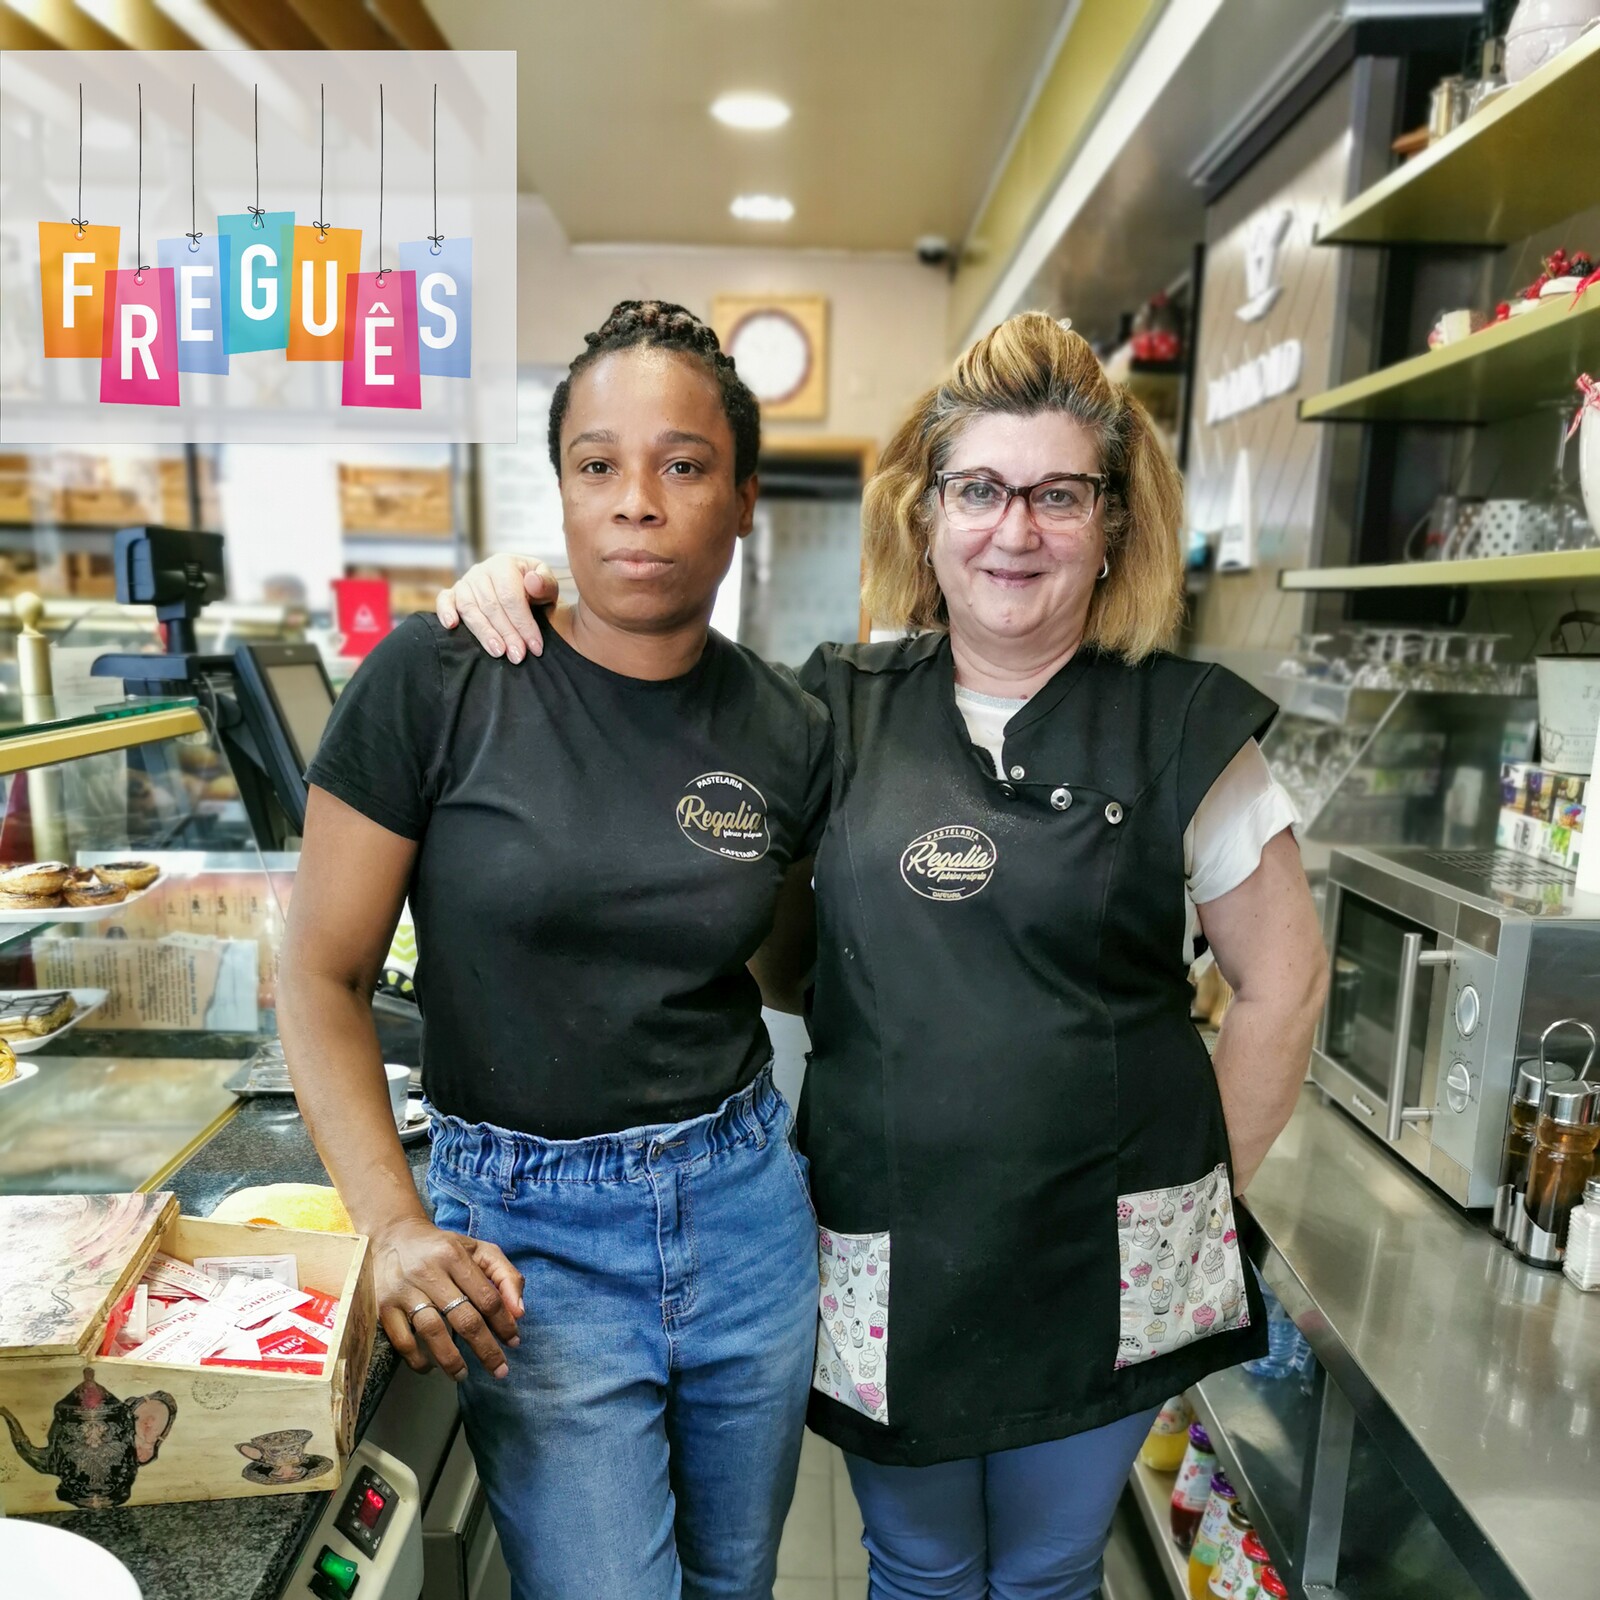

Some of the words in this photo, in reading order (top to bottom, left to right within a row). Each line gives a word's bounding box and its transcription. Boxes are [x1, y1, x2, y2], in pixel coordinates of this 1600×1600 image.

[696, 776, 743, 791] PASTELARIA
[680, 795, 762, 837] Regalia
[926, 828, 979, 841] PASTELARIA
[906, 841, 992, 878] Regalia
